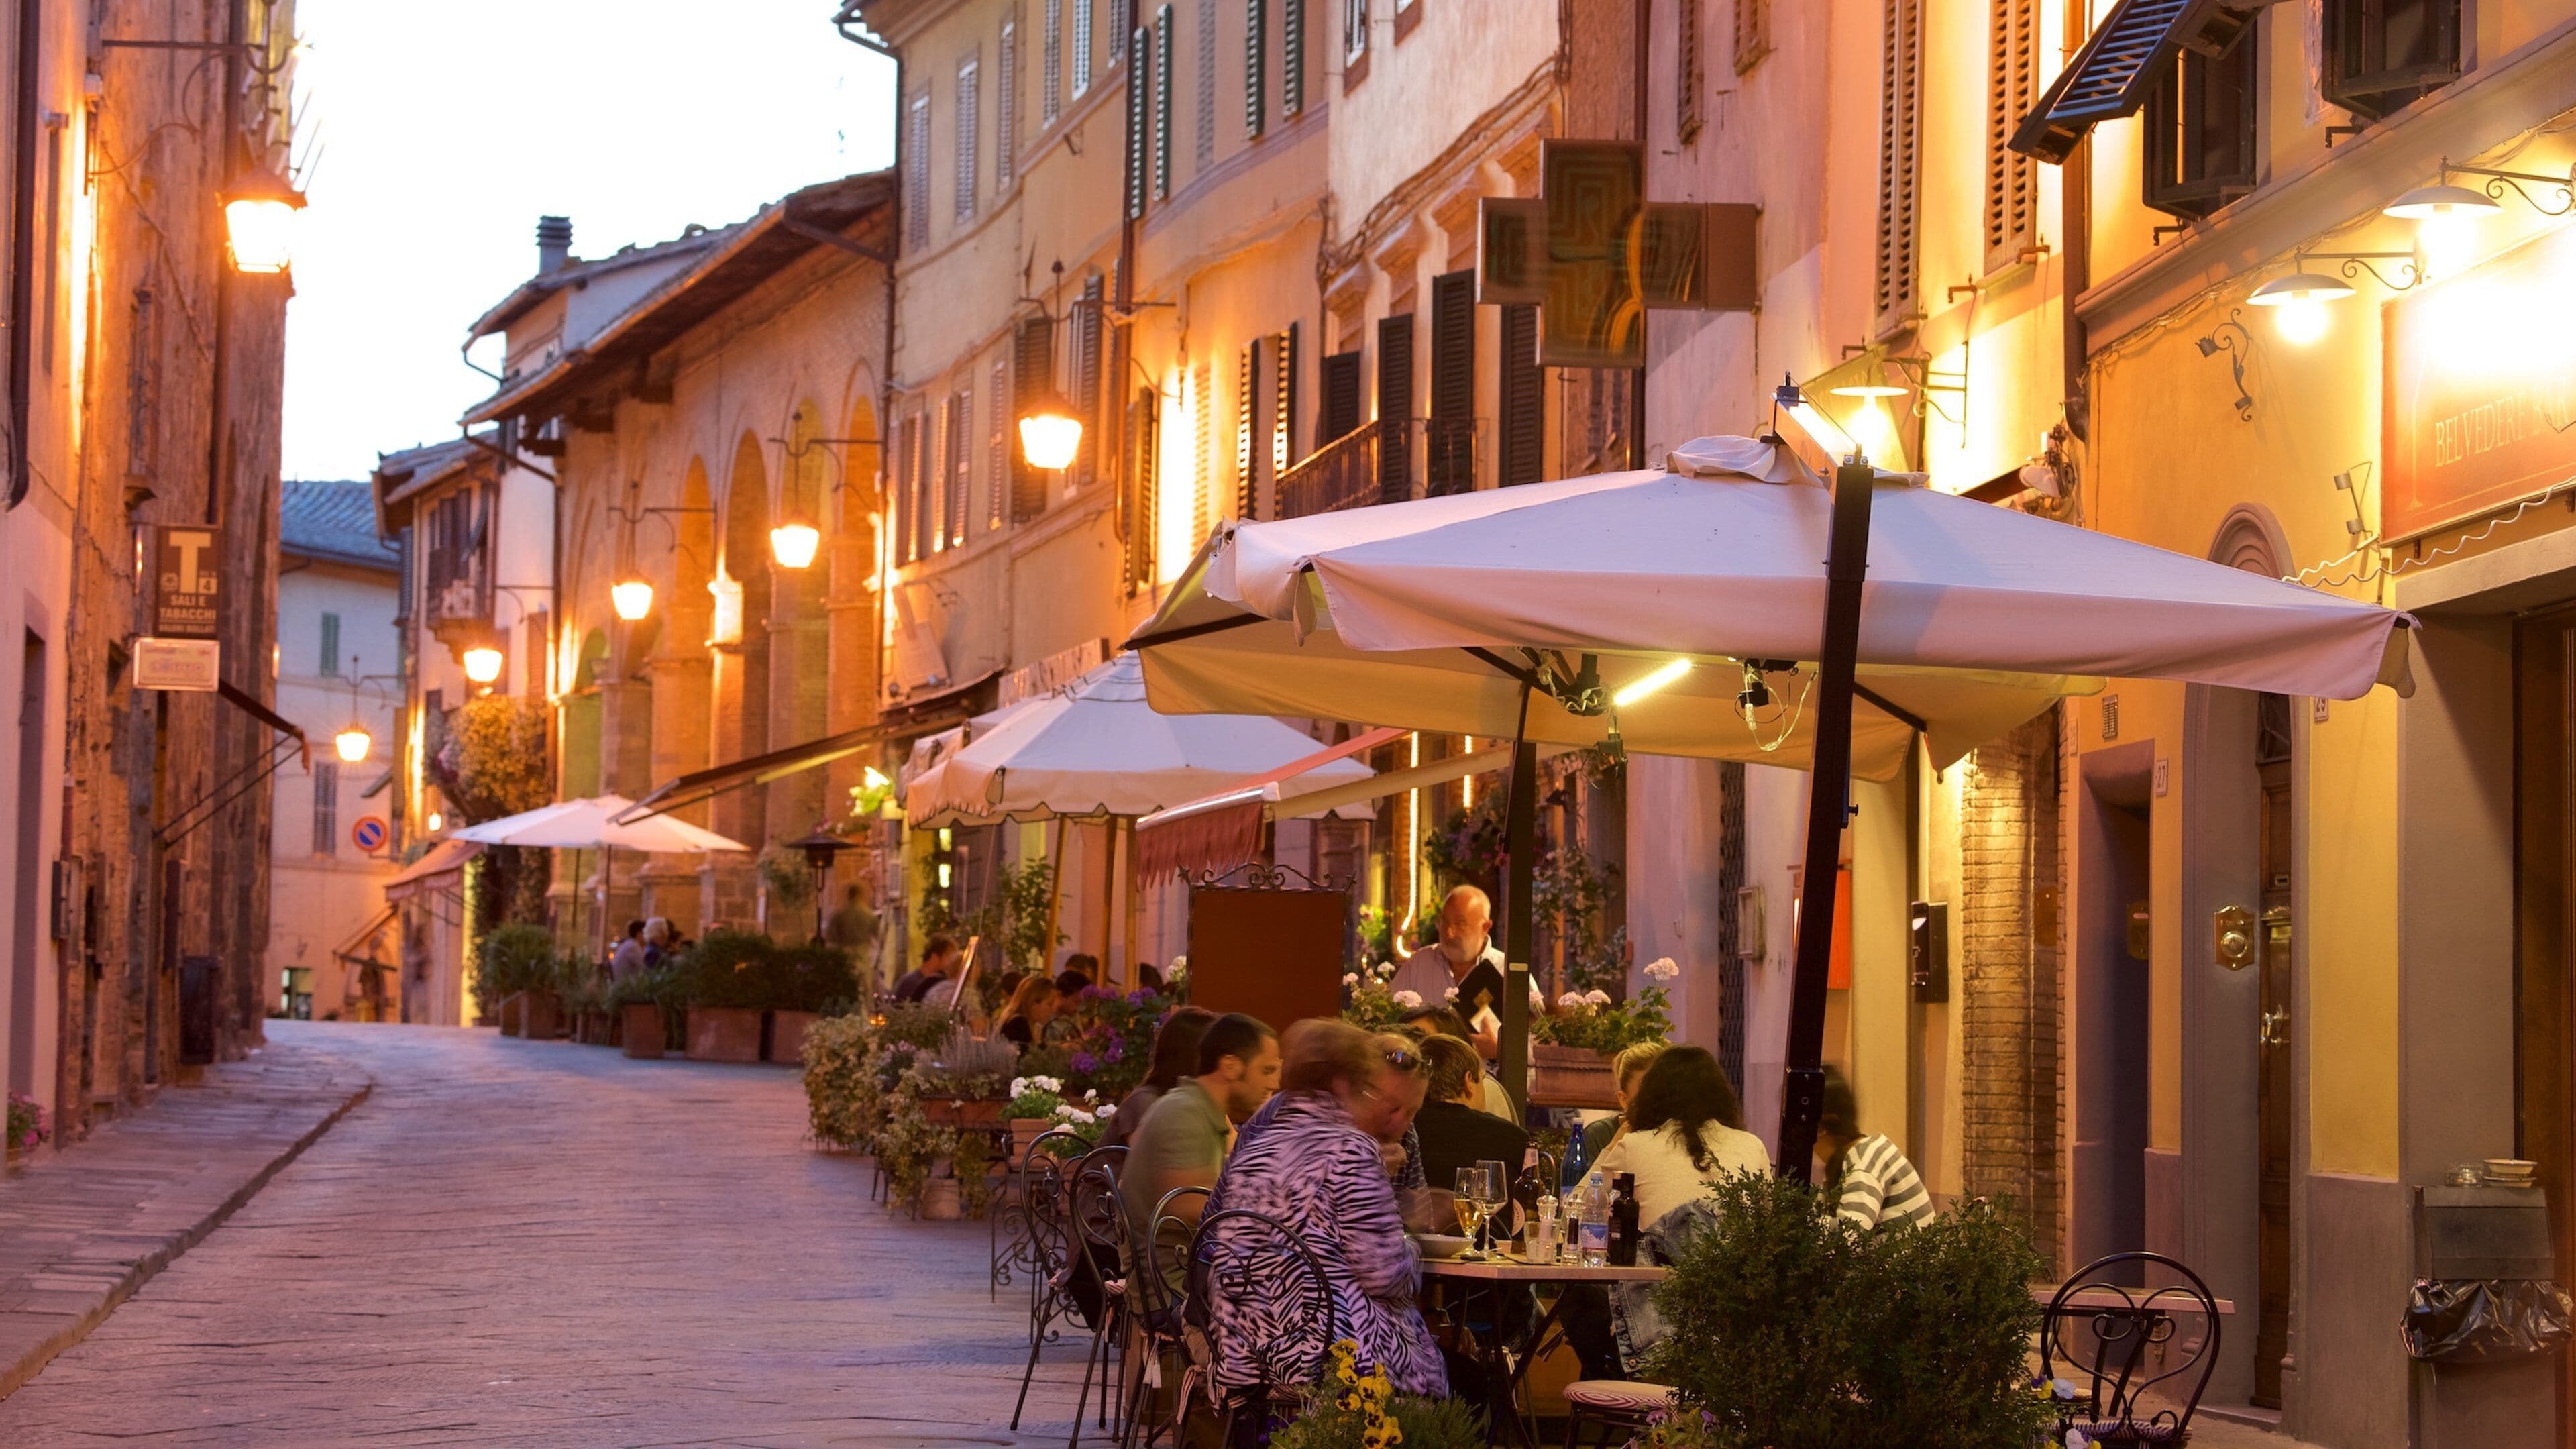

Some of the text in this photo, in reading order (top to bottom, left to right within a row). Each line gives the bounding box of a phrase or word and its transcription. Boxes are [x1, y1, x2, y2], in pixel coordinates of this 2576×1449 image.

[2435, 376, 2570, 468] BELVEDERE BAR
[170, 532, 211, 594] T
[170, 594, 207, 606] SALI E
[160, 607, 217, 619] TABACCHI
[2316, 696, 2326, 712] 29
[2157, 764, 2166, 789] 27
